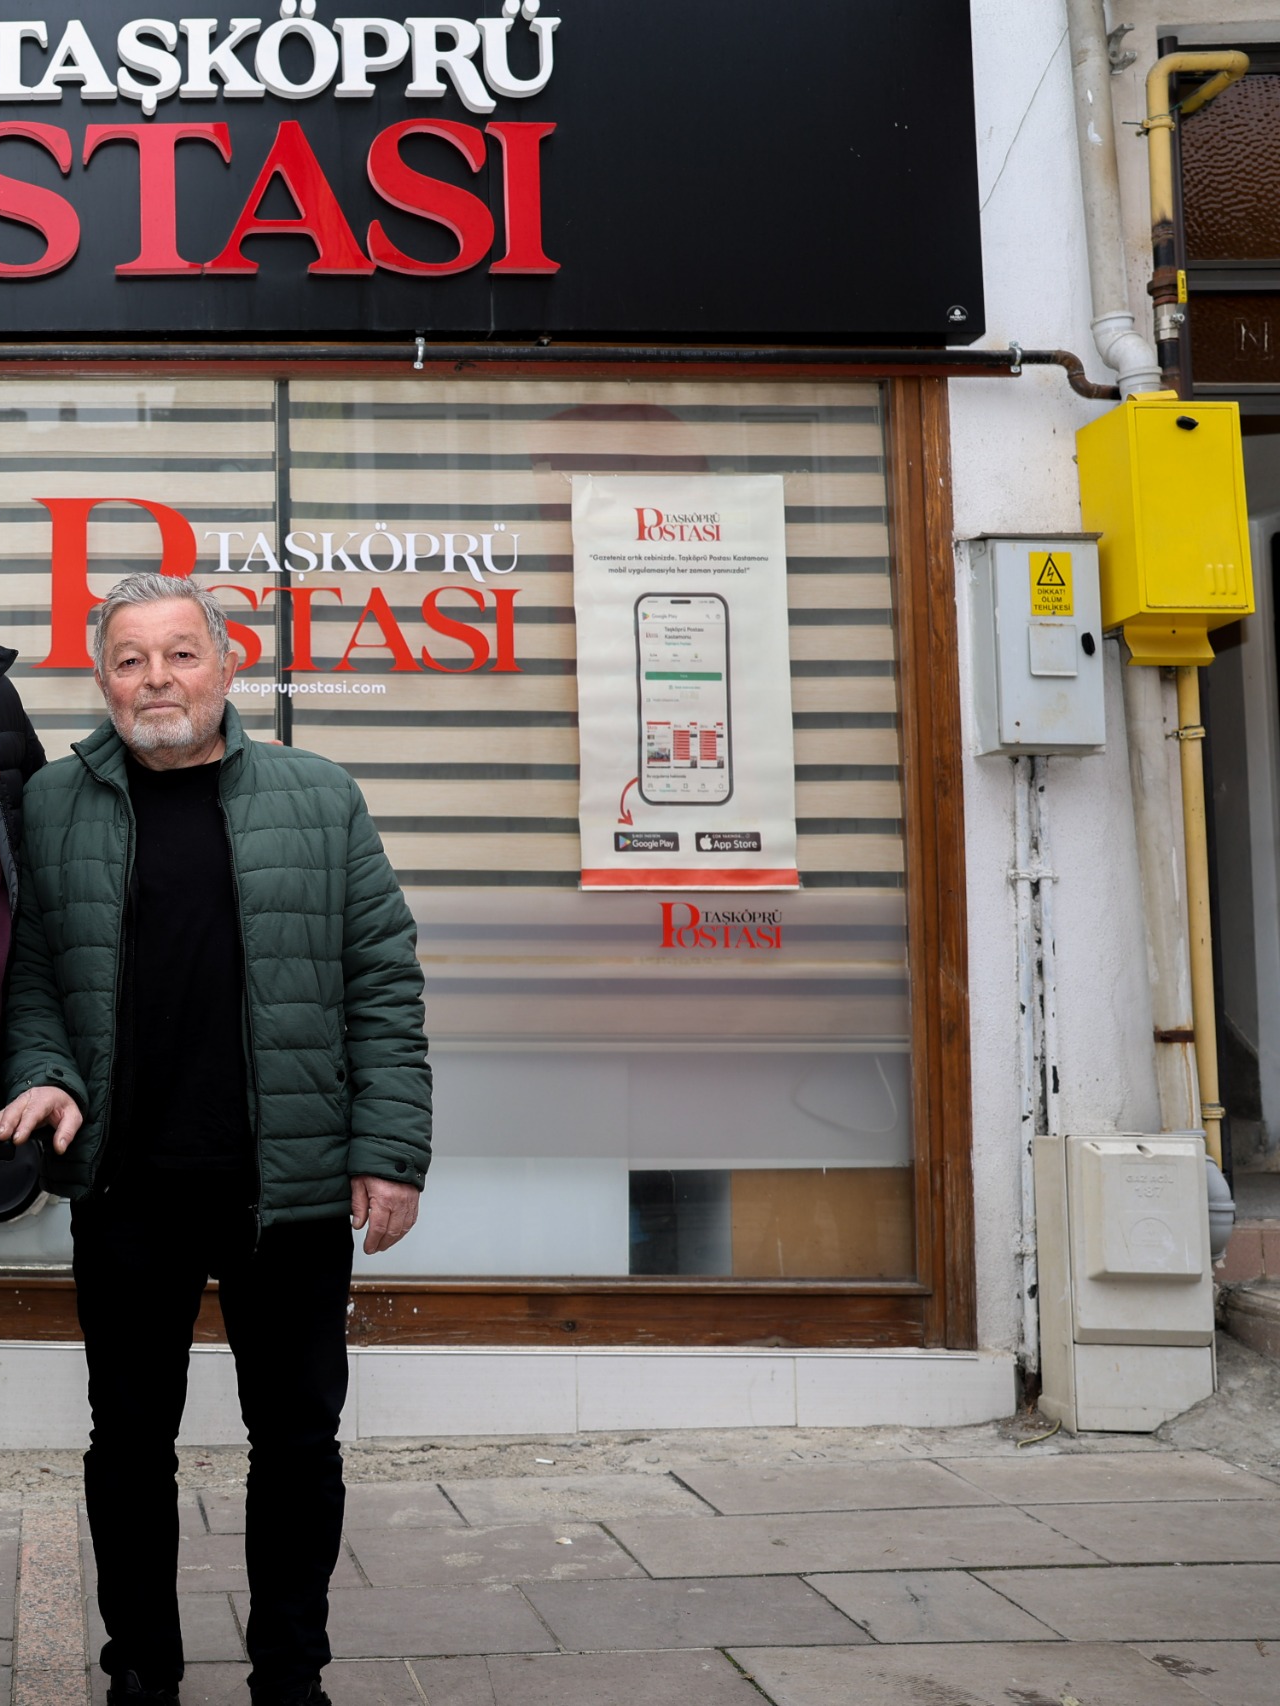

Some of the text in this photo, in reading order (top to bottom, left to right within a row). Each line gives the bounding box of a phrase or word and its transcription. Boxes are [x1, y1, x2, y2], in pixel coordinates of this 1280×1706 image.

[634, 507, 721, 541] POSTASI
[664, 512, 720, 524] TAŞKÖPRÜ
[204, 522, 520, 583] TAŞKÖPRÜ
[678, 554, 708, 562] Taşköprü
[628, 566, 675, 575] uygulamasıyla
[30, 497, 524, 672] PSTASI
[228, 680, 387, 697] skoprupostasi.com
[632, 839, 674, 849] Google Play
[713, 840, 758, 850] App Store
[702, 909, 782, 925] TAŞKÖPRÜ
[658, 902, 783, 949] POSTASI
